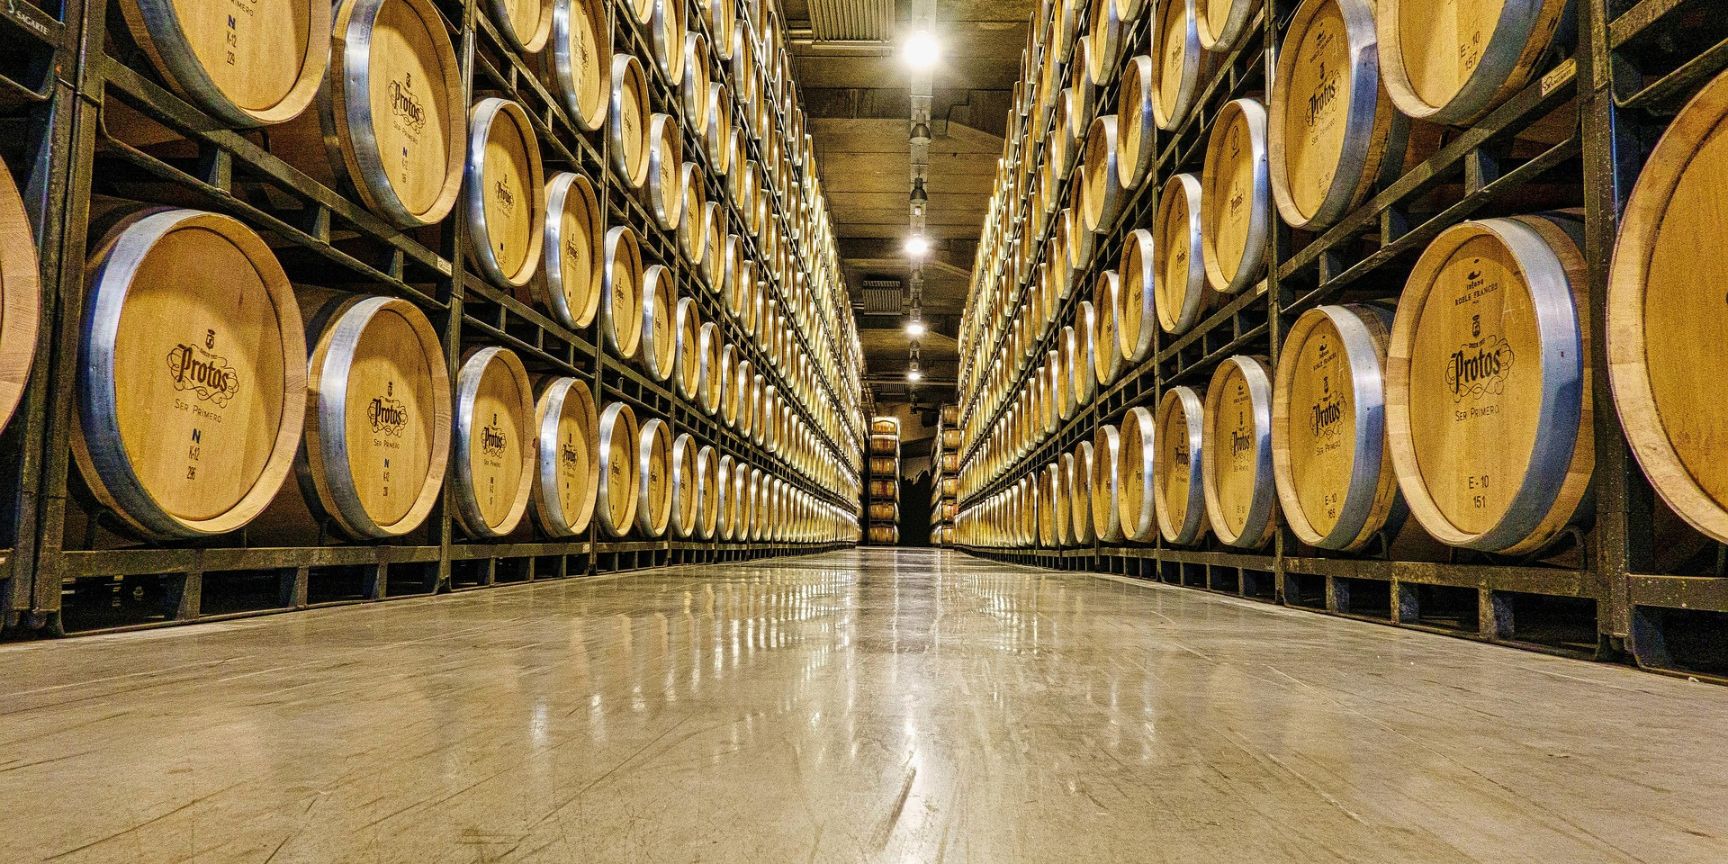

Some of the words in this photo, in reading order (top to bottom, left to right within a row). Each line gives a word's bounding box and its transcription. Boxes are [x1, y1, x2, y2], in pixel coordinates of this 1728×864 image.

[16, 10, 49, 36] SAGARTE
[227, 14, 236, 31] N
[1464, 50, 1479, 72] 157
[392, 79, 420, 122] Protos
[402, 146, 408, 158] N
[177, 343, 230, 393] Protos
[1450, 348, 1502, 395] Protos
[174, 398, 189, 412] SER
[192, 404, 222, 423] PRIMERO
[372, 398, 402, 427] Protos
[1312, 400, 1341, 437] Protos
[1455, 410, 1467, 422] SER
[1470, 404, 1500, 420] PRIMERO
[191, 428, 202, 444] N
[188, 445, 201, 461] K-12
[383, 458, 390, 469] N
[1472, 495, 1487, 509] 151
